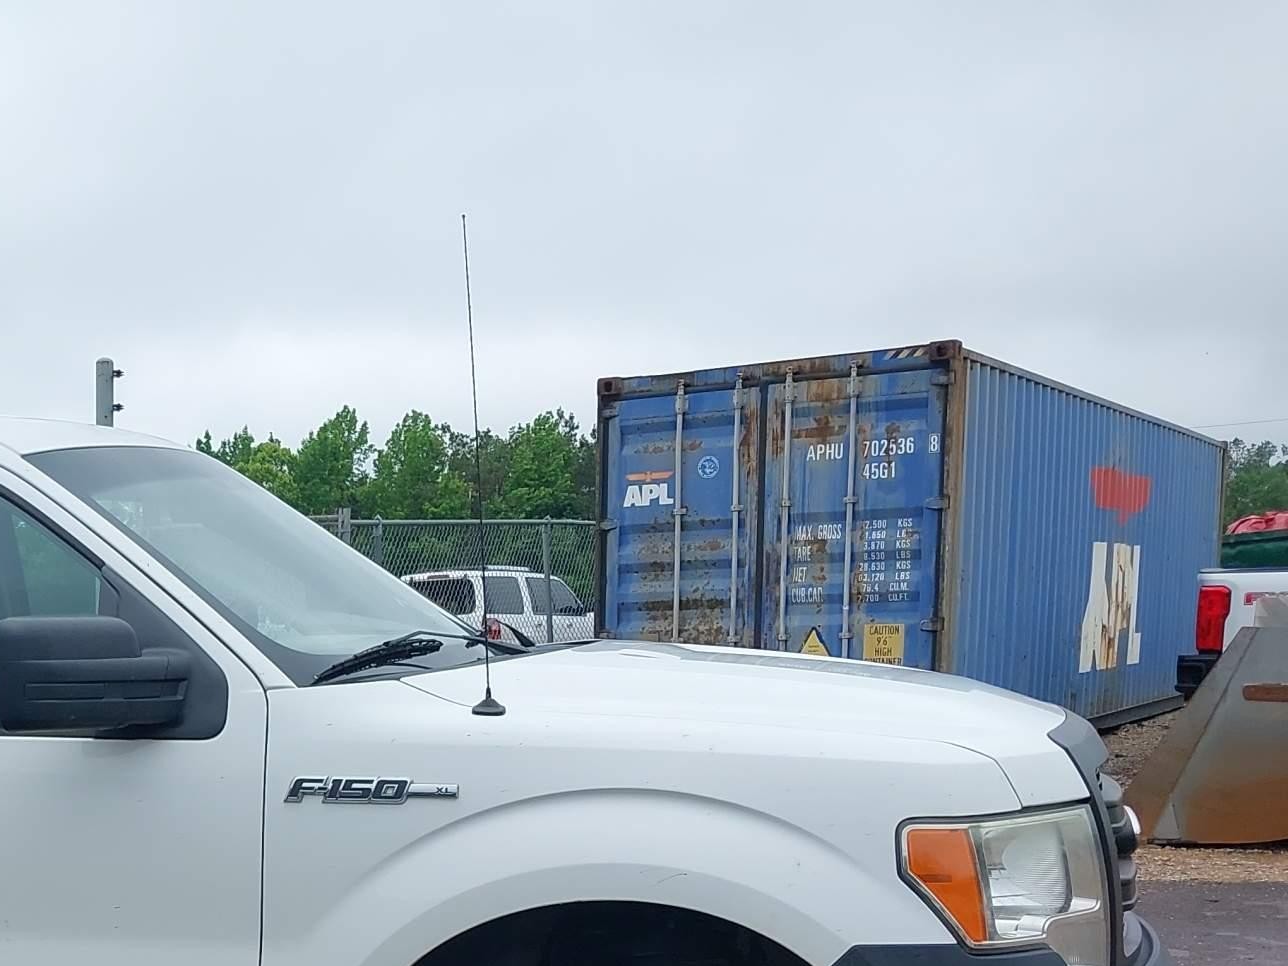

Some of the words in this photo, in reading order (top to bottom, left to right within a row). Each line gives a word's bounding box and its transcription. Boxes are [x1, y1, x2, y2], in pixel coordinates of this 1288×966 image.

[807, 443, 844, 461] APHU
[862, 437, 914, 457] 702536
[929, 434, 939, 453] 8
[863, 462, 896, 479] 45G1
[623, 483, 674, 507] APL
[897, 518, 913, 527] KGS
[818, 524, 842, 539] GROSS
[896, 540, 911, 549] KGS
[794, 546, 811, 561] TARE
[896, 551, 911, 559] LBS
[896, 561, 911, 570] KGS
[895, 572, 911, 580] LBS
[1079, 541, 1141, 674] APL
[869, 625, 900, 635] CAUTION
[874, 647, 892, 657] HIGH
[284, 776, 412, 803] F-150
